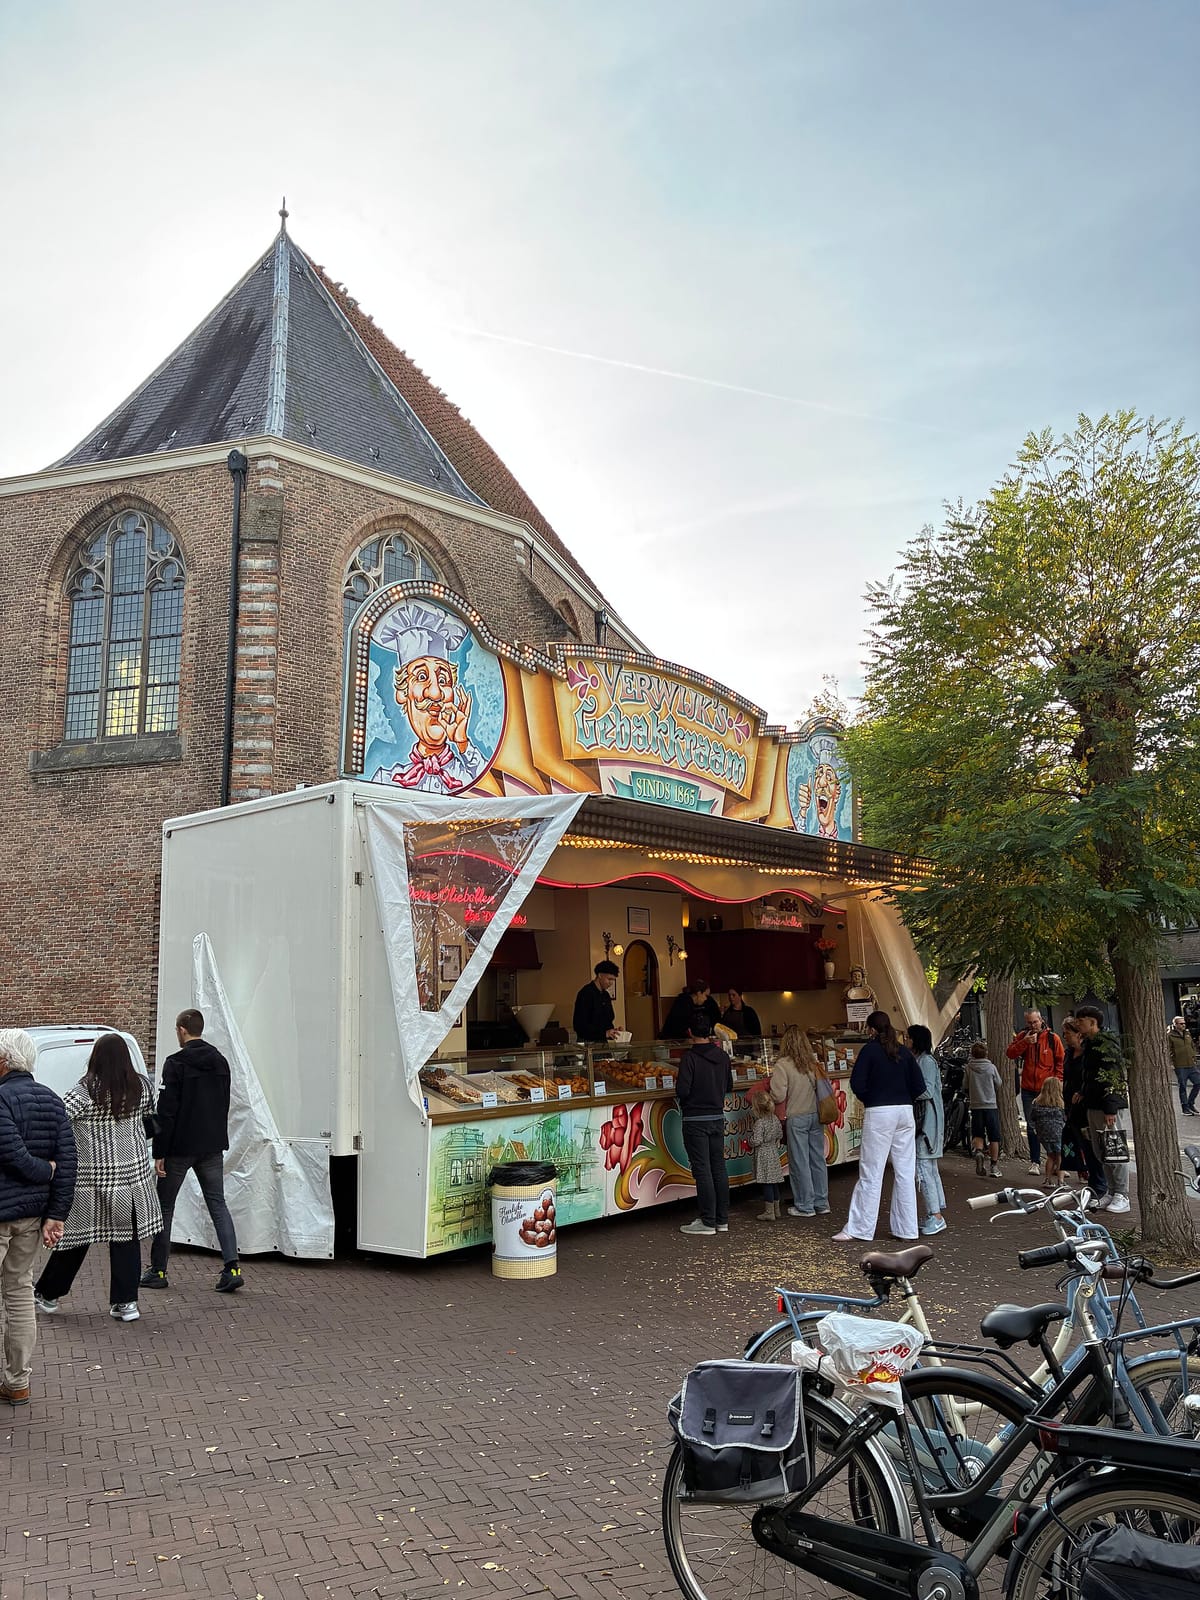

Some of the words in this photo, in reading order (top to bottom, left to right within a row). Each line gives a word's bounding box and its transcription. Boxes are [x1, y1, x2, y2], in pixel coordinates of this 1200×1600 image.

[594, 661, 729, 736] VERWIJK'S
[574, 696, 748, 792] Gebakkraam
[636, 778, 671, 802] SINDS
[673, 786, 695, 807] 1865
[1019, 1450, 1058, 1500] GIA
